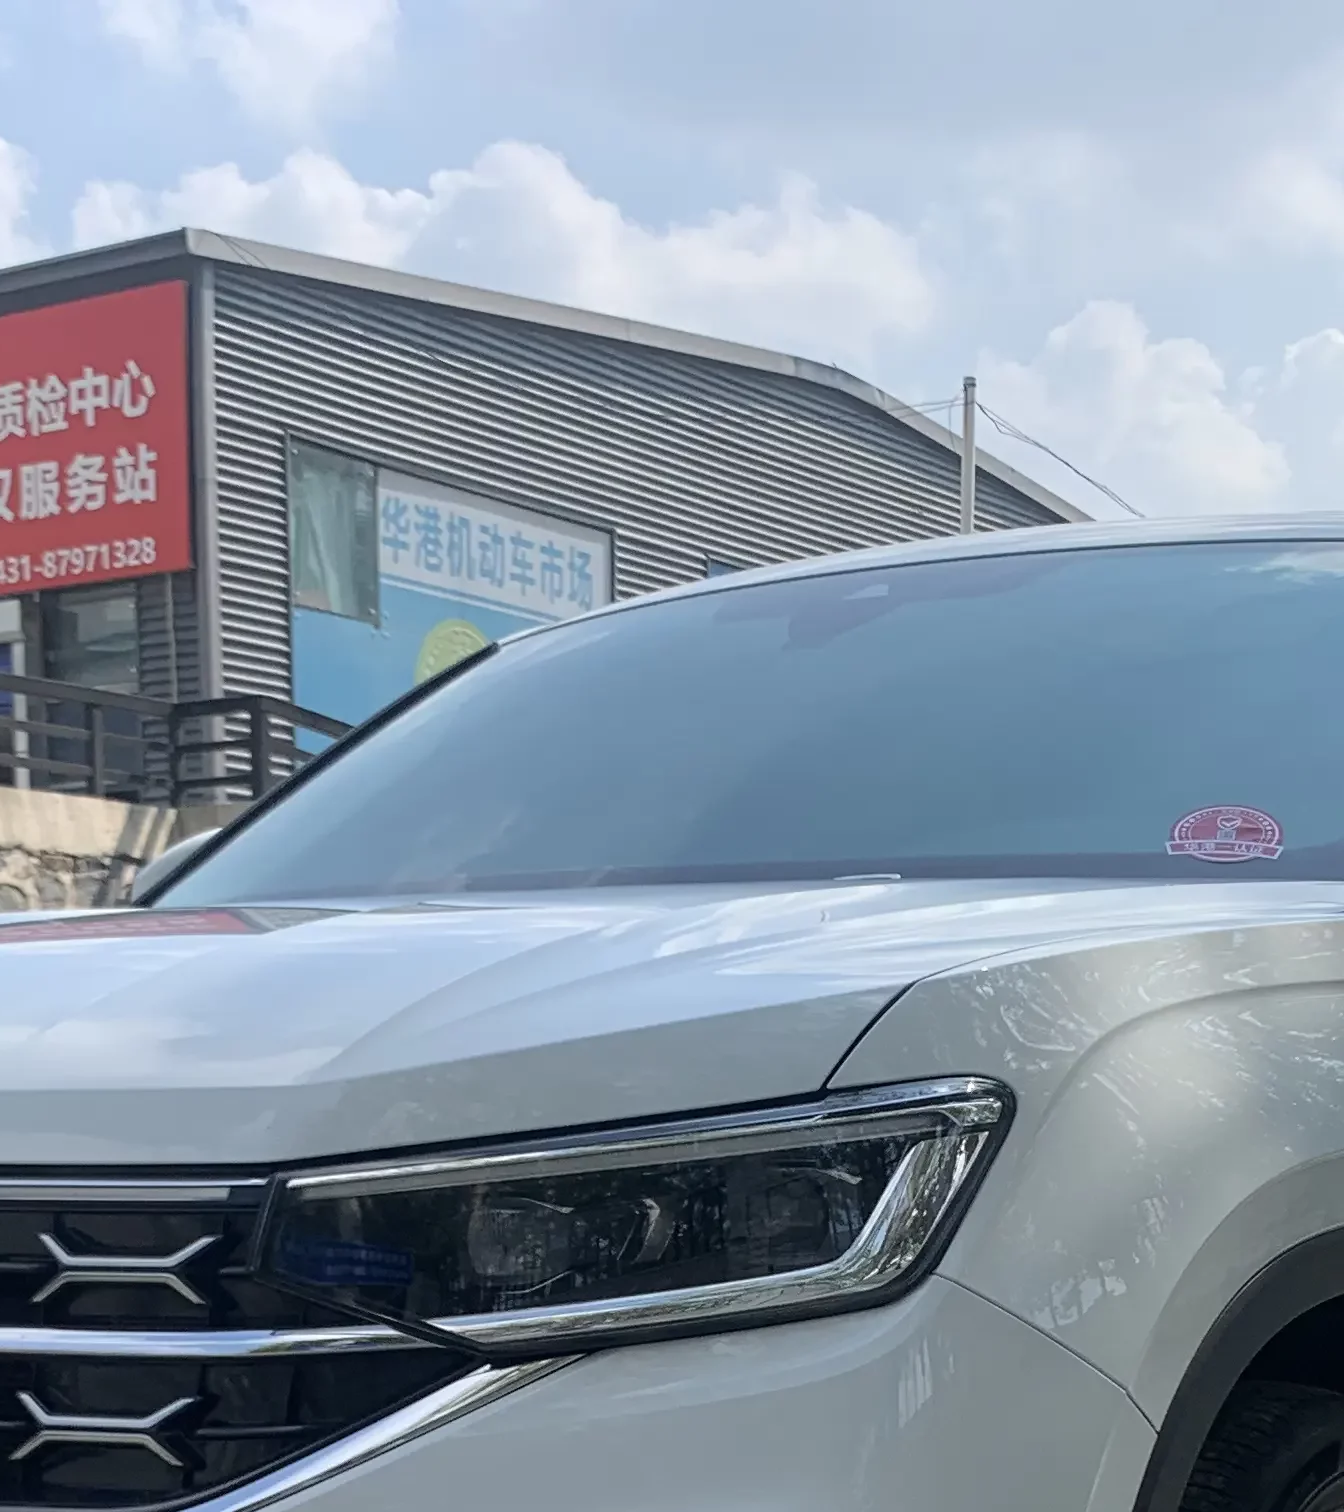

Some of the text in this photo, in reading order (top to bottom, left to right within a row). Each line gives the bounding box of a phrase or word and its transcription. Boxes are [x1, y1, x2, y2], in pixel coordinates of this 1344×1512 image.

[381, 494, 595, 612] 华港机动车市场
